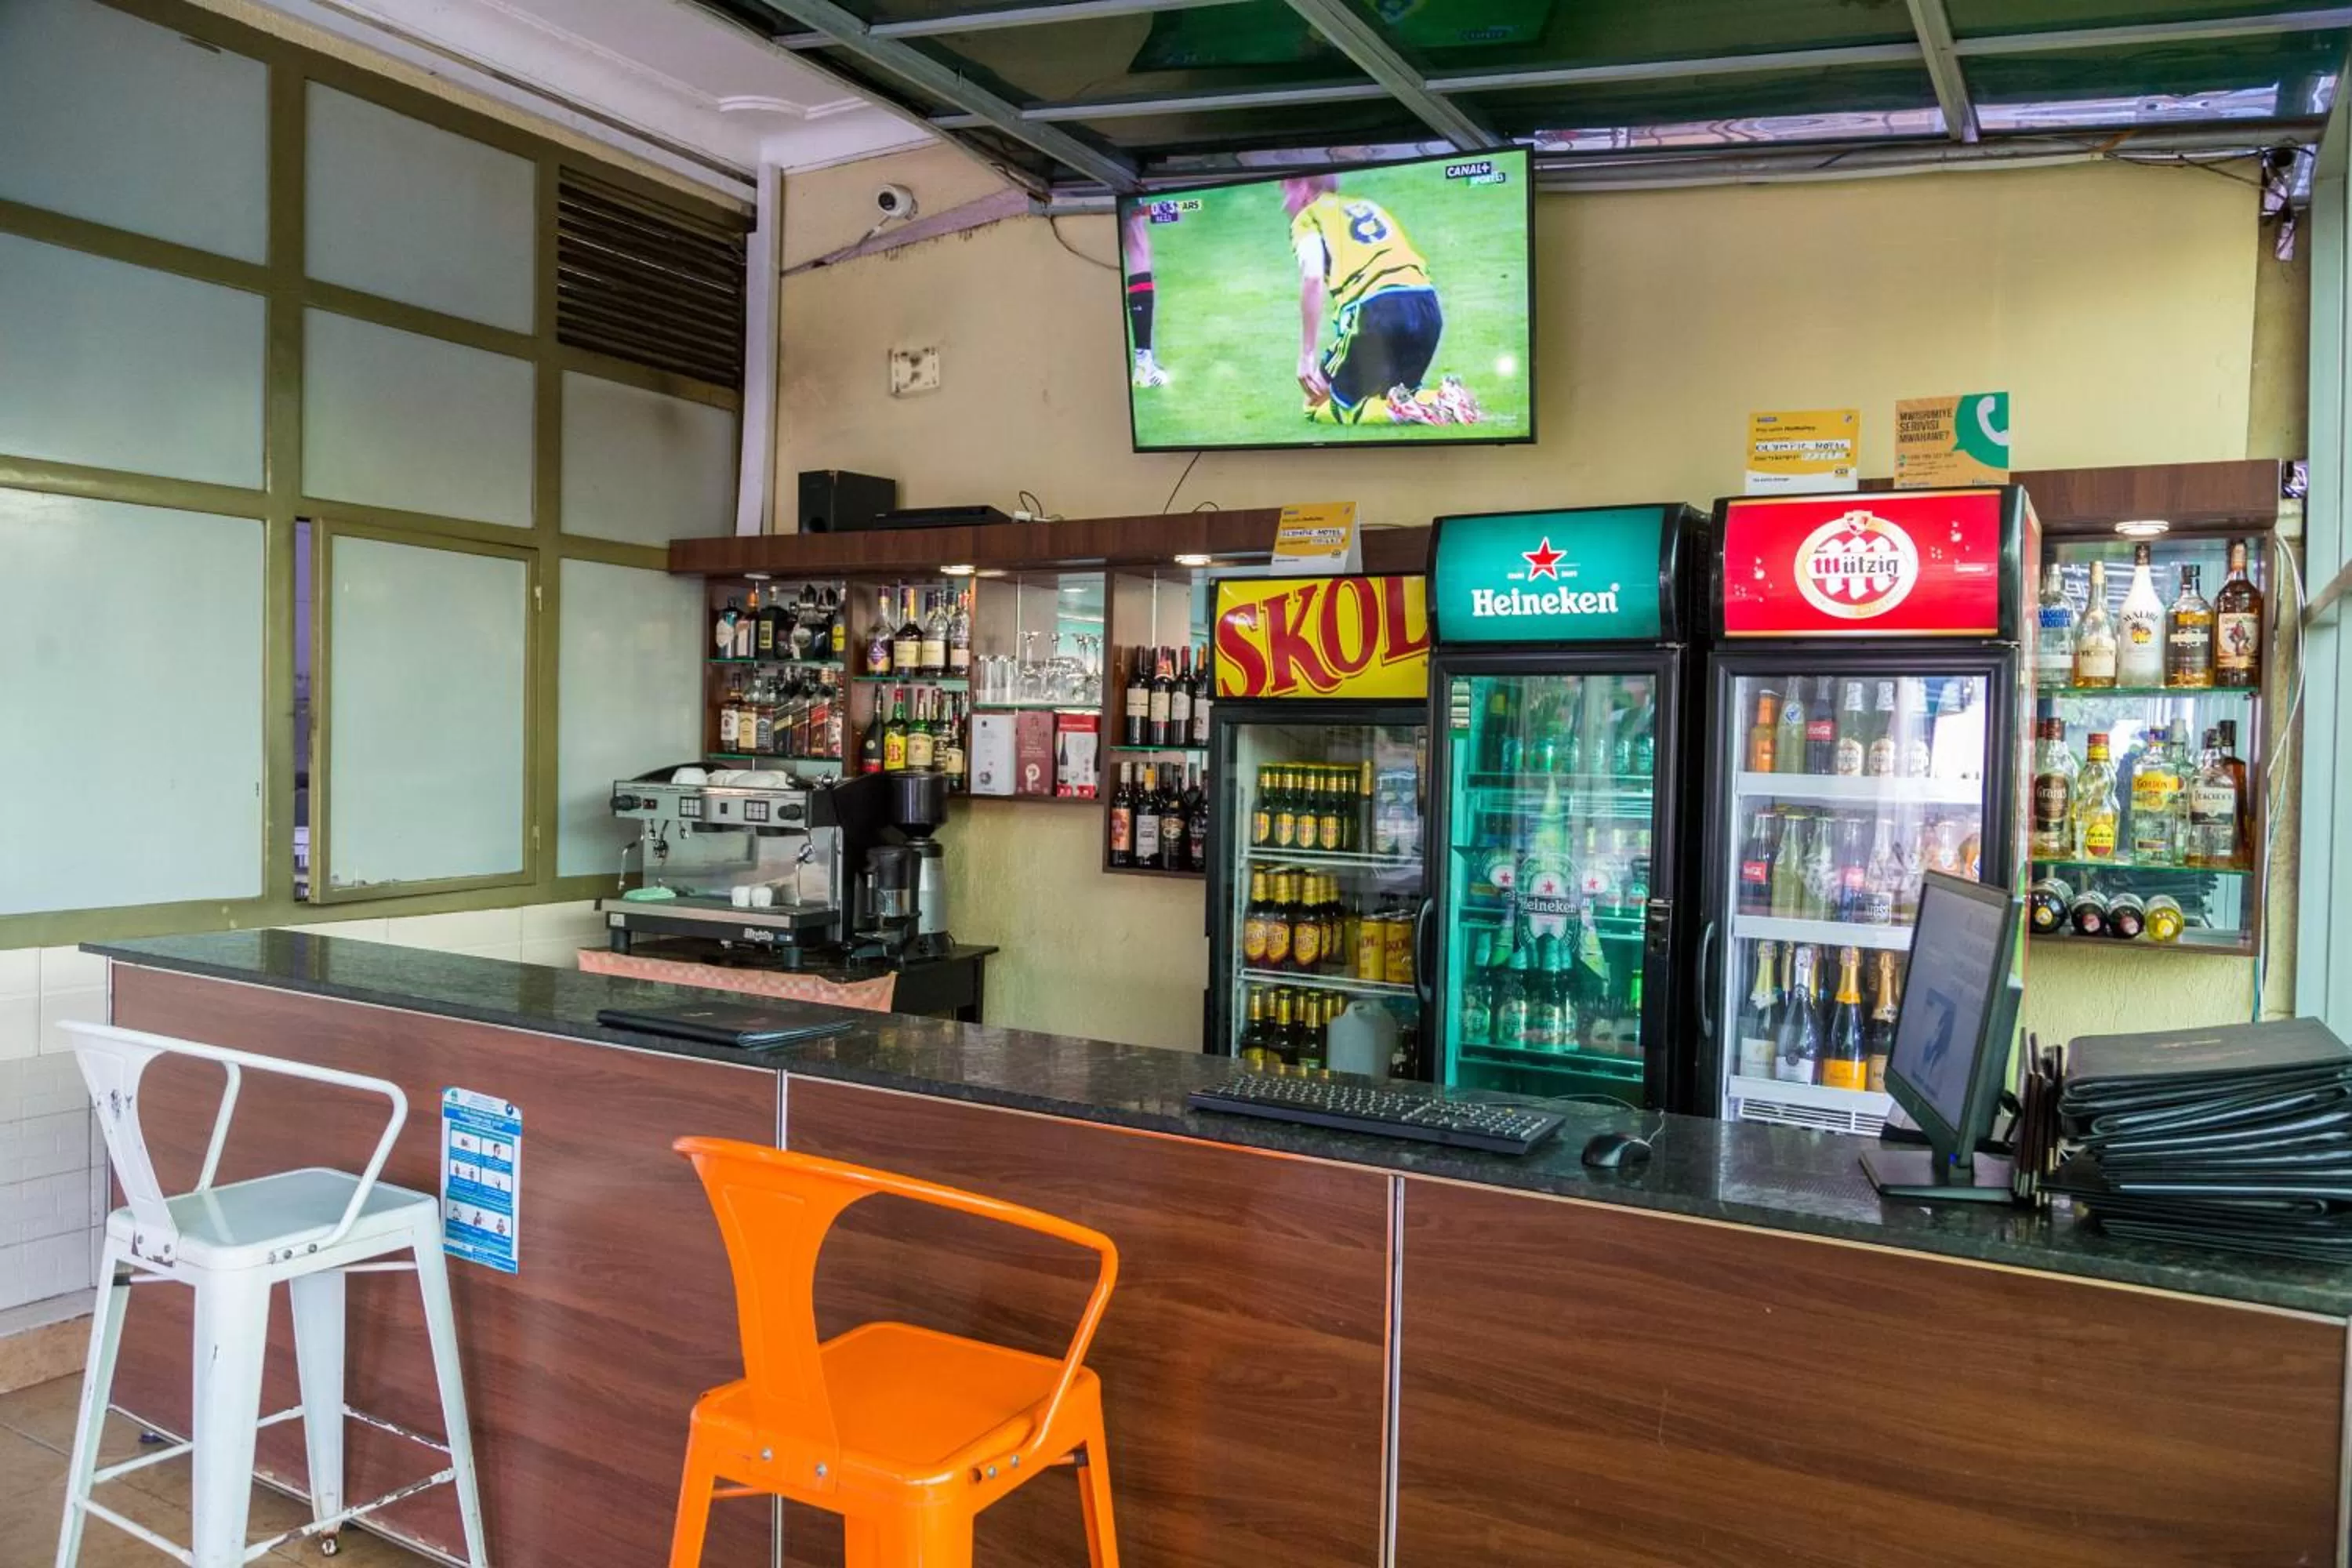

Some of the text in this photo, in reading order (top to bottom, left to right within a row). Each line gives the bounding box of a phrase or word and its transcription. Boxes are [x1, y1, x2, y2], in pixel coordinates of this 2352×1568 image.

[1447, 163, 1490, 177] CANAL+
[1471, 586, 1619, 617] Heineken
[1216, 576, 1430, 697] SKOL
